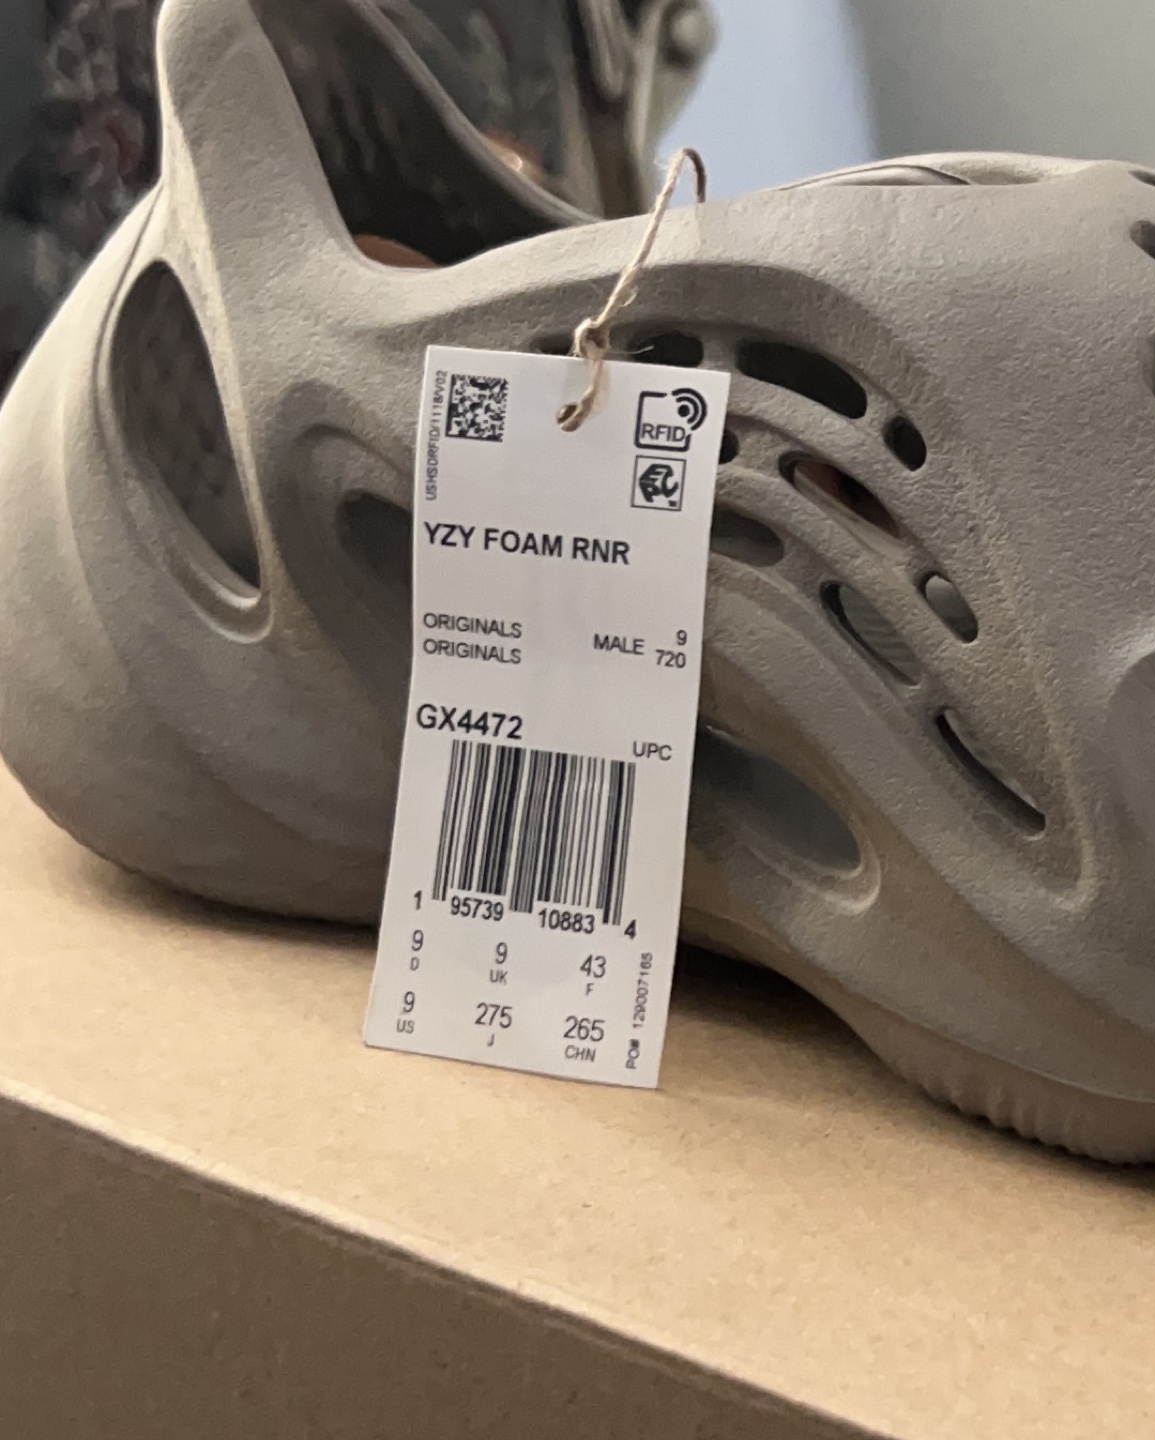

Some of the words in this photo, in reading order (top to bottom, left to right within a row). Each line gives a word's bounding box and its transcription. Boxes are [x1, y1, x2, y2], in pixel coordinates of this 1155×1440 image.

[641, 422, 686, 442] RFID
[423, 521, 476, 549] YZY
[483, 528, 563, 558] FOAM
[571, 537, 631, 565] RNR
[422, 612, 522, 639] ORIGINALS
[676, 629, 687, 646] 9
[422, 638, 522, 664] ORIGINALS
[593, 633, 645, 656] MALE
[655, 649, 686, 669] 720
[416, 703, 523, 740] GX4472
[632, 740, 673, 762] UPC
[413, 890, 423, 911] 1
[450, 896, 504, 921] 95739
[538, 909, 596, 935] 10883
[624, 919, 638, 940] 4
[411, 929, 424, 952] 9
[410, 956, 421, 972] D
[495, 942, 508, 964] 9
[489, 969, 508, 985] UK
[580, 955, 606, 979] 43
[585, 983, 594, 997] F
[403, 991, 415, 1013] 9
[475, 1002, 513, 1029] 275
[396, 1019, 414, 1035] US
[563, 1015, 605, 1042] 265
[487, 1033, 495, 1047] J
[564, 1044, 597, 1062] CHN
